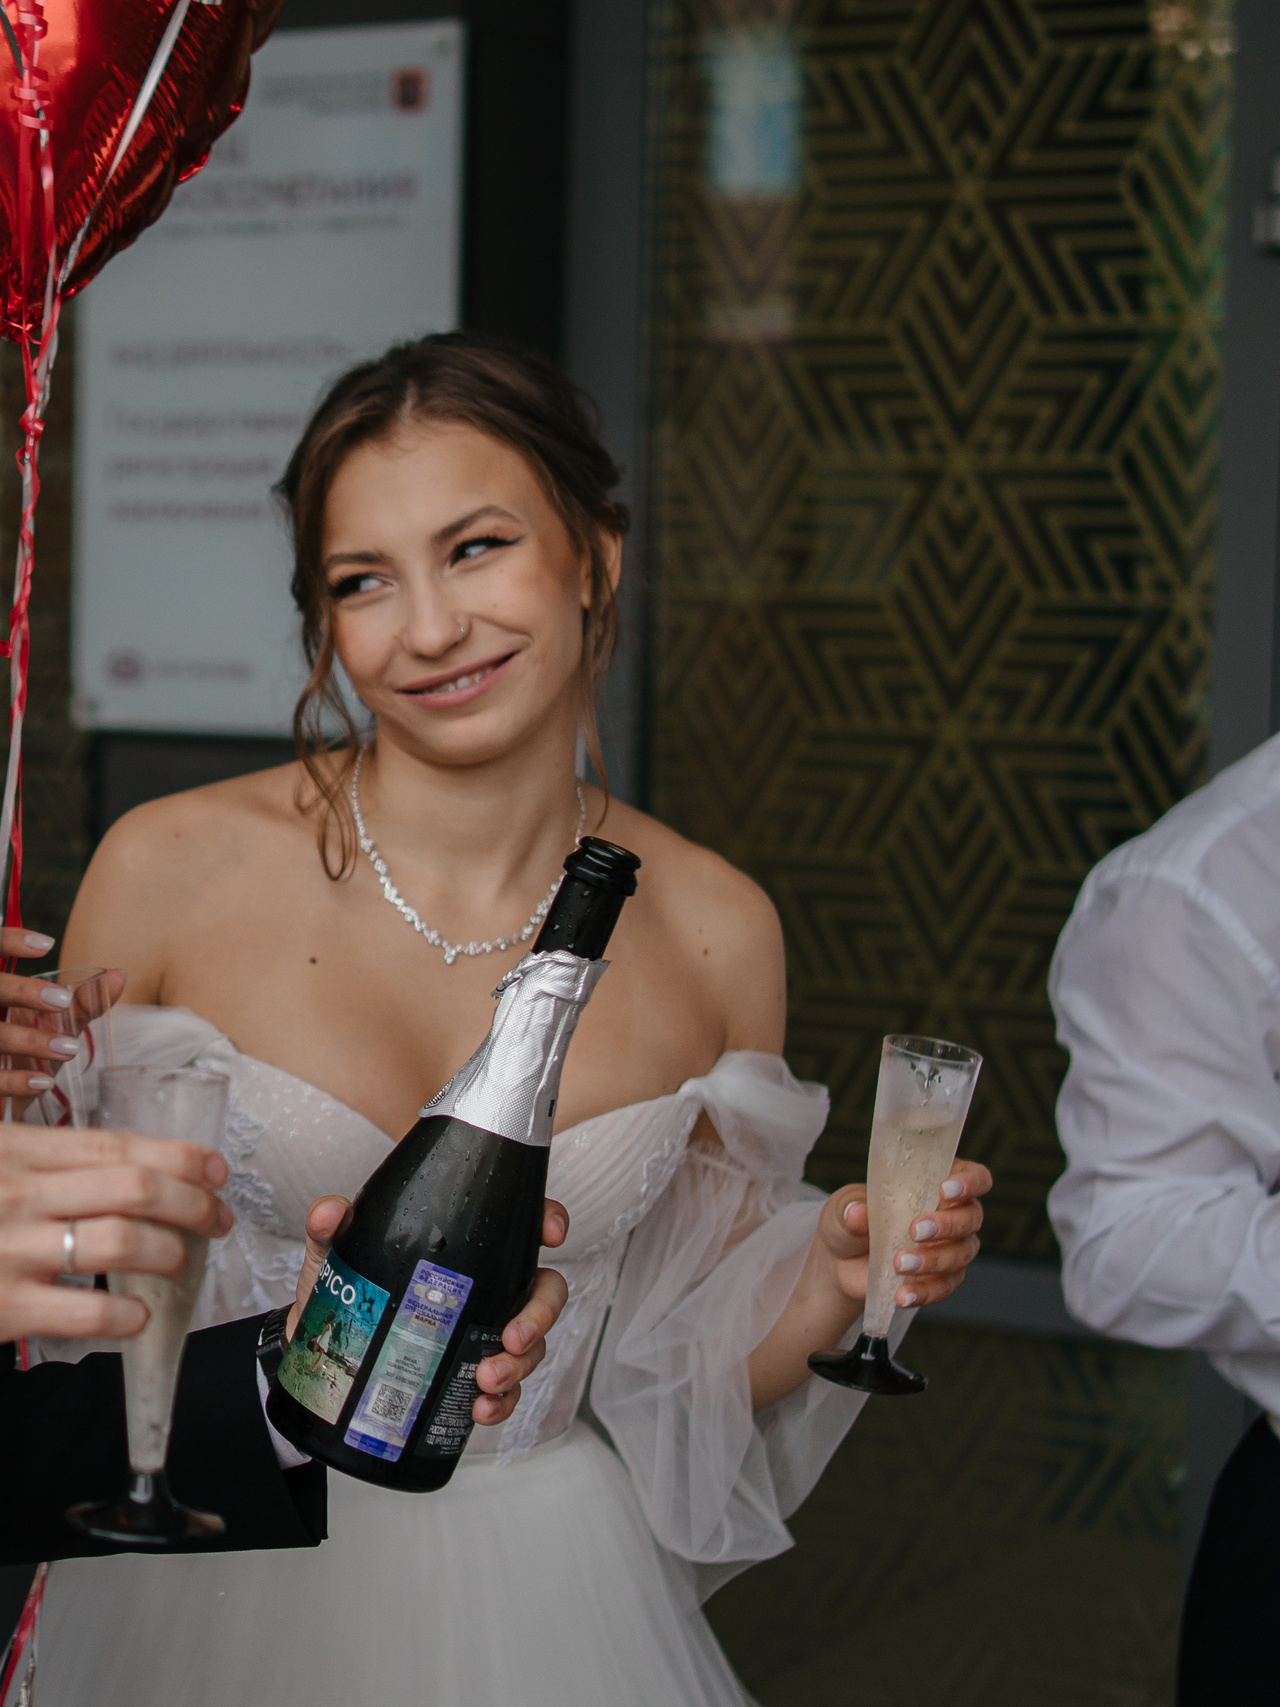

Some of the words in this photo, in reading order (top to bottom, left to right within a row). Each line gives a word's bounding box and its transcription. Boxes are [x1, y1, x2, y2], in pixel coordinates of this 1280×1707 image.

[419, 1275, 462, 1295] ФЕДЕРАЦИЯ
[420, 1268, 465, 1290] РОССИЙСКАЯ
[404, 1303, 451, 1326] СПЕЦИАЛЬНАЯ
[407, 1298, 453, 1320] ФЕДЕРАЛЬНАЯ
[414, 1314, 437, 1328] МАРКА
